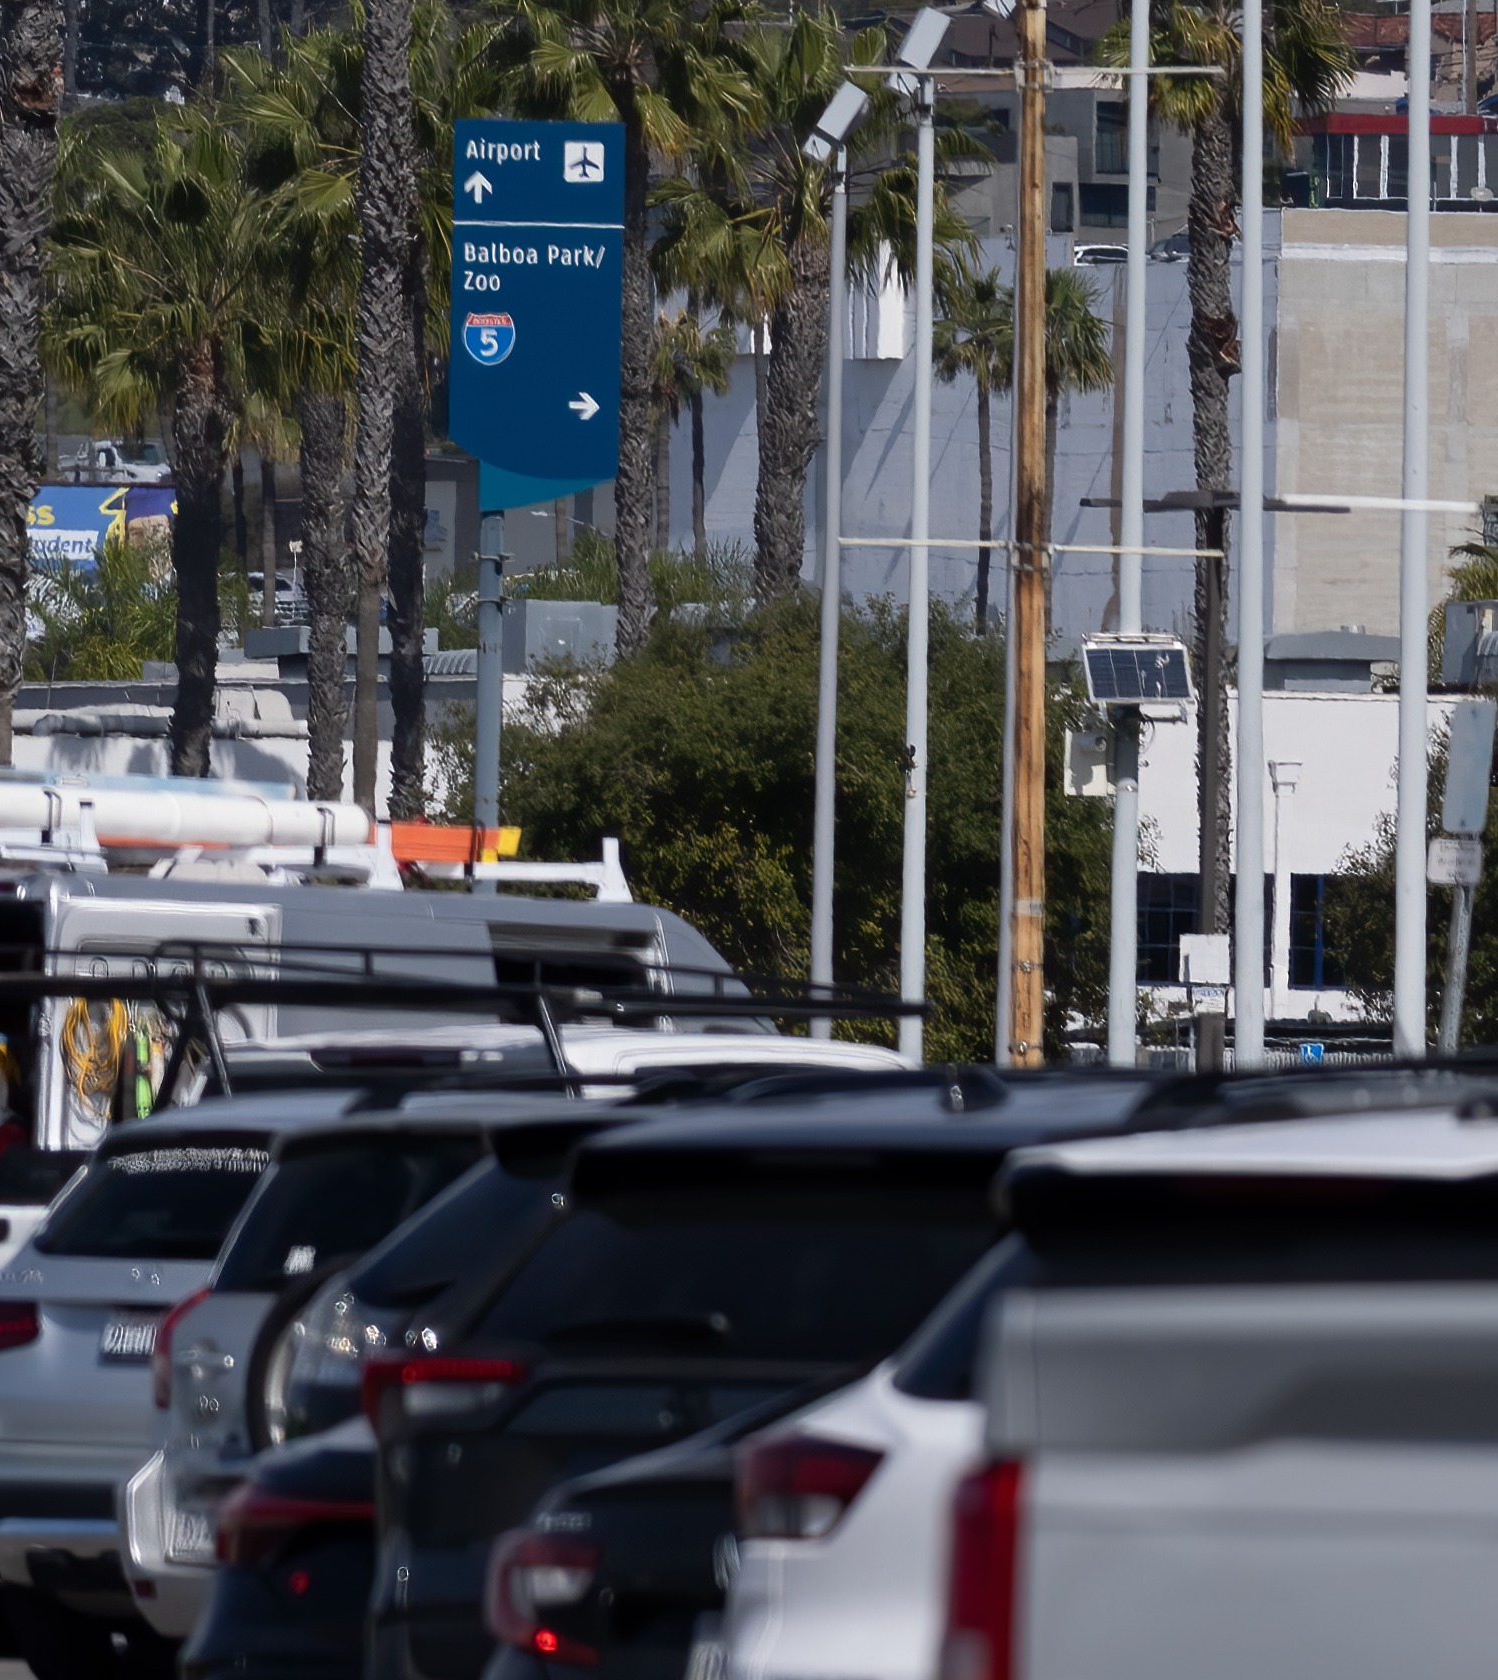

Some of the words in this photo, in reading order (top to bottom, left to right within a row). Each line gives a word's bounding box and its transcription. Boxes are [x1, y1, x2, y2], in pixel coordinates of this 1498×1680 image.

[465, 138, 541, 165] Airport
[463, 241, 538, 265] Balboa
[547, 244, 606, 269] Park/
[463, 270, 501, 292] Zoo
[480, 328, 499, 357] 5
